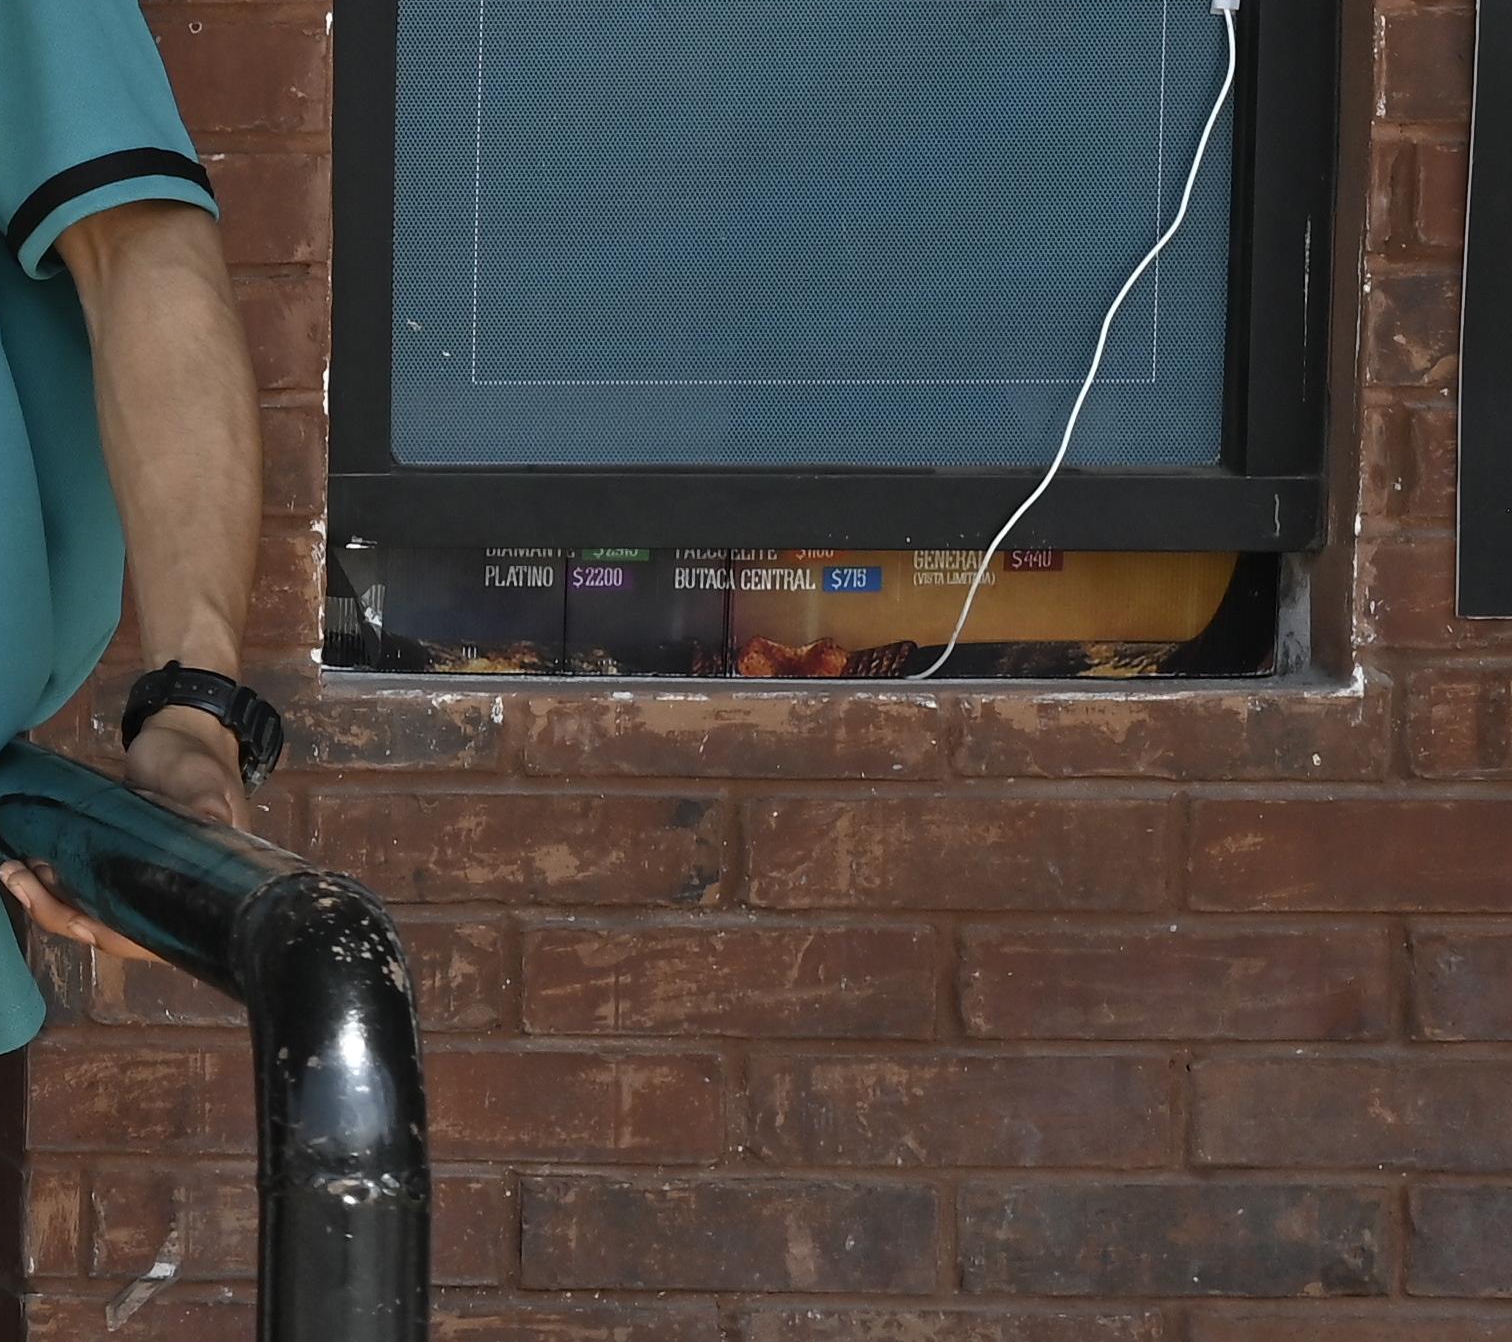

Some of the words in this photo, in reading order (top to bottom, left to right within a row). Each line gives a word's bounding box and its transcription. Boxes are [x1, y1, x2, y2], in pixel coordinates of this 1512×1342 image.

[484, 565, 554, 587] PLATINO
[572, 567, 623, 588] $2200
[674, 567, 736, 590] BUTACA
[741, 568, 816, 591] CENTRAL
[831, 569, 867, 590] $715
